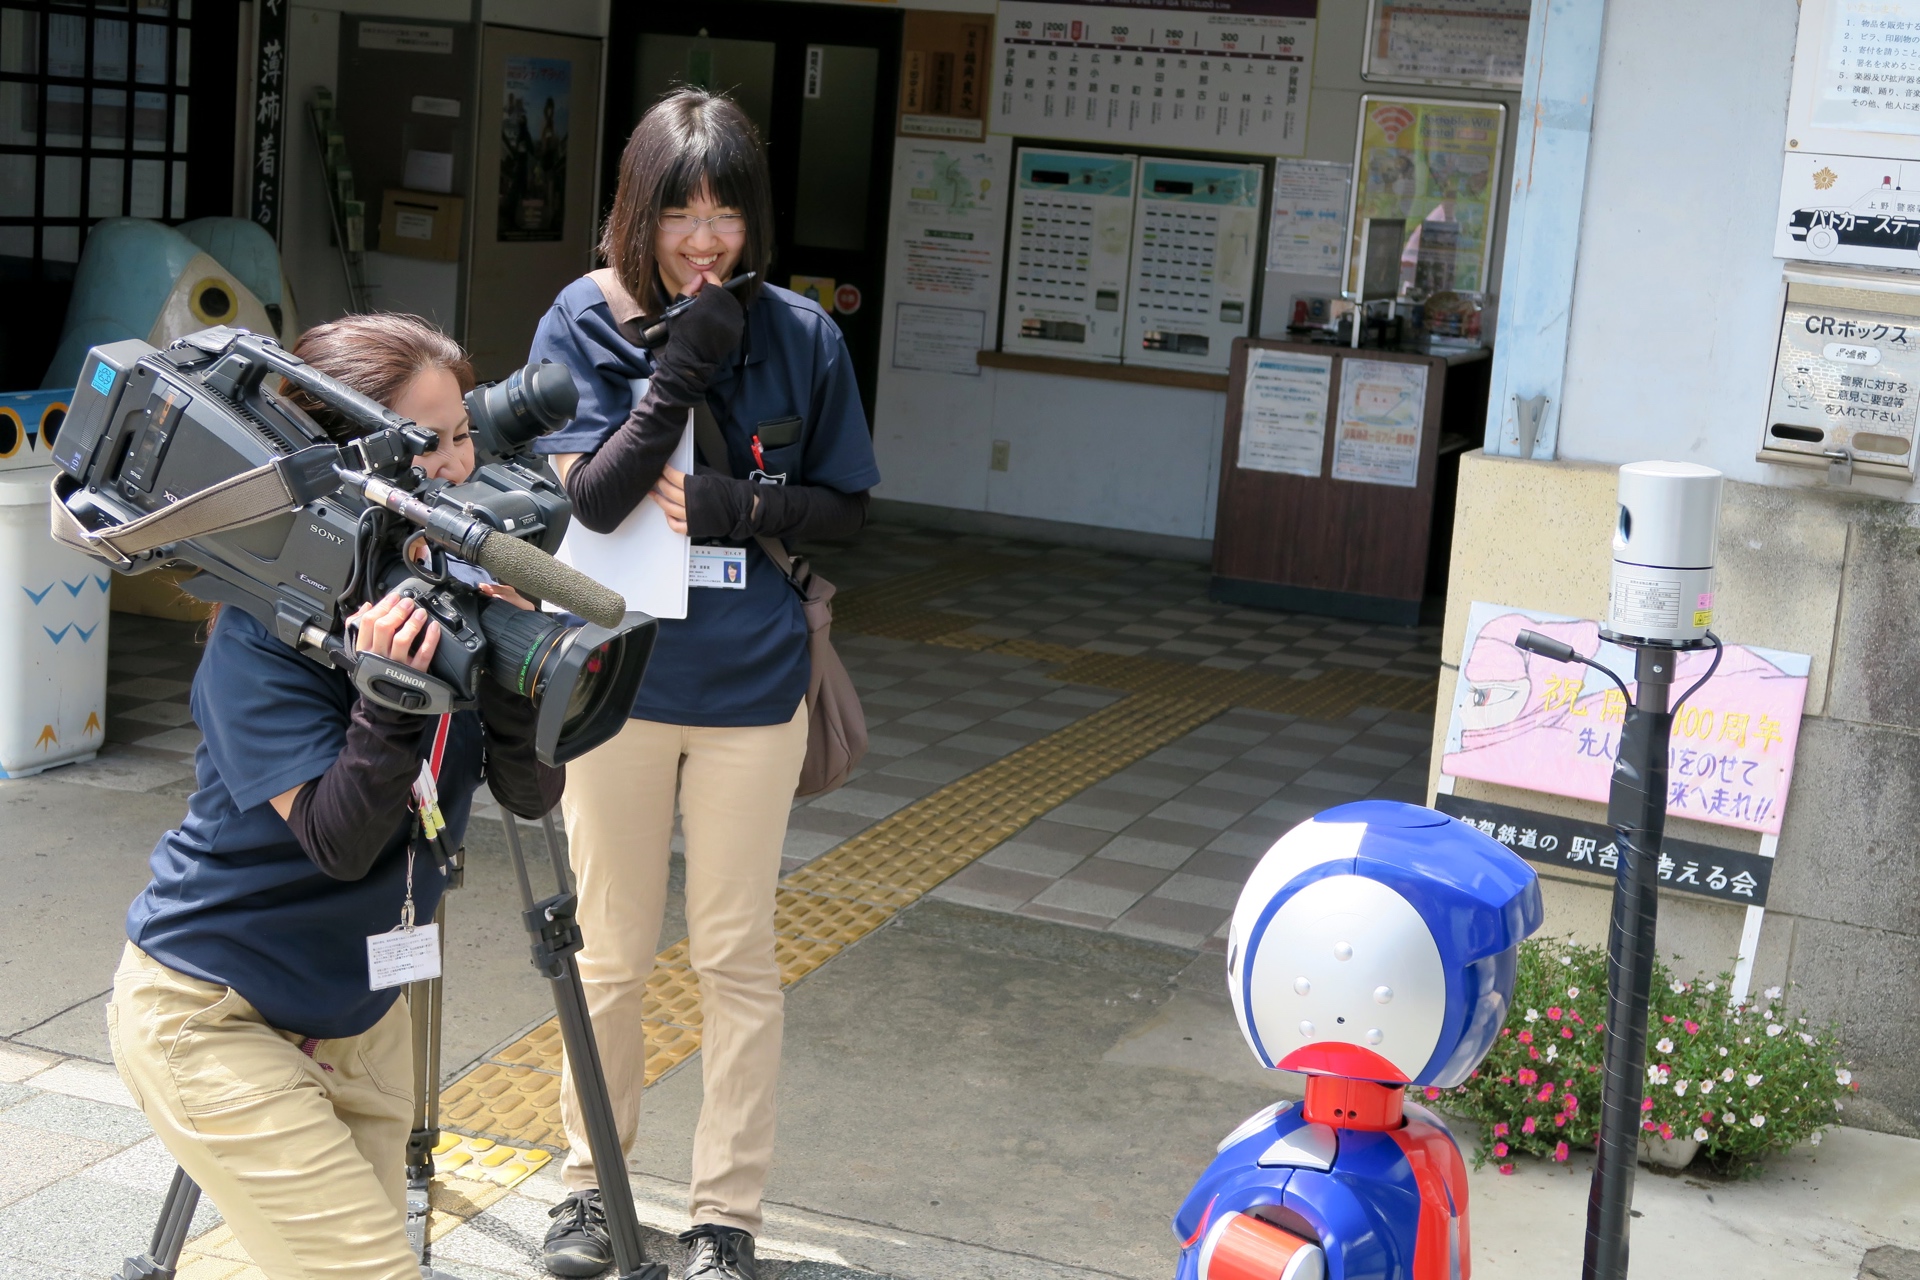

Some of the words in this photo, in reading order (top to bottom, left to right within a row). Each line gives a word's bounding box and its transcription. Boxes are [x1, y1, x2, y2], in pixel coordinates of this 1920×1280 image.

[1014, 20, 1033, 30] 260
[1047, 22, 1065, 32] 200
[1110, 26, 1129, 37] 200
[1165, 29, 1184, 39] 260
[1220, 33, 1239, 43] 300
[1276, 36, 1296, 46] 360
[1805, 315, 1908, 344] CRボックス
[1840, 375, 1908, 394] 警察に対する
[1825, 404, 1901, 423] を入れて下さい
[309, 523, 345, 546] SONY
[299, 573, 329, 592] Exmor
[384, 668, 427, 690] FUJINON
